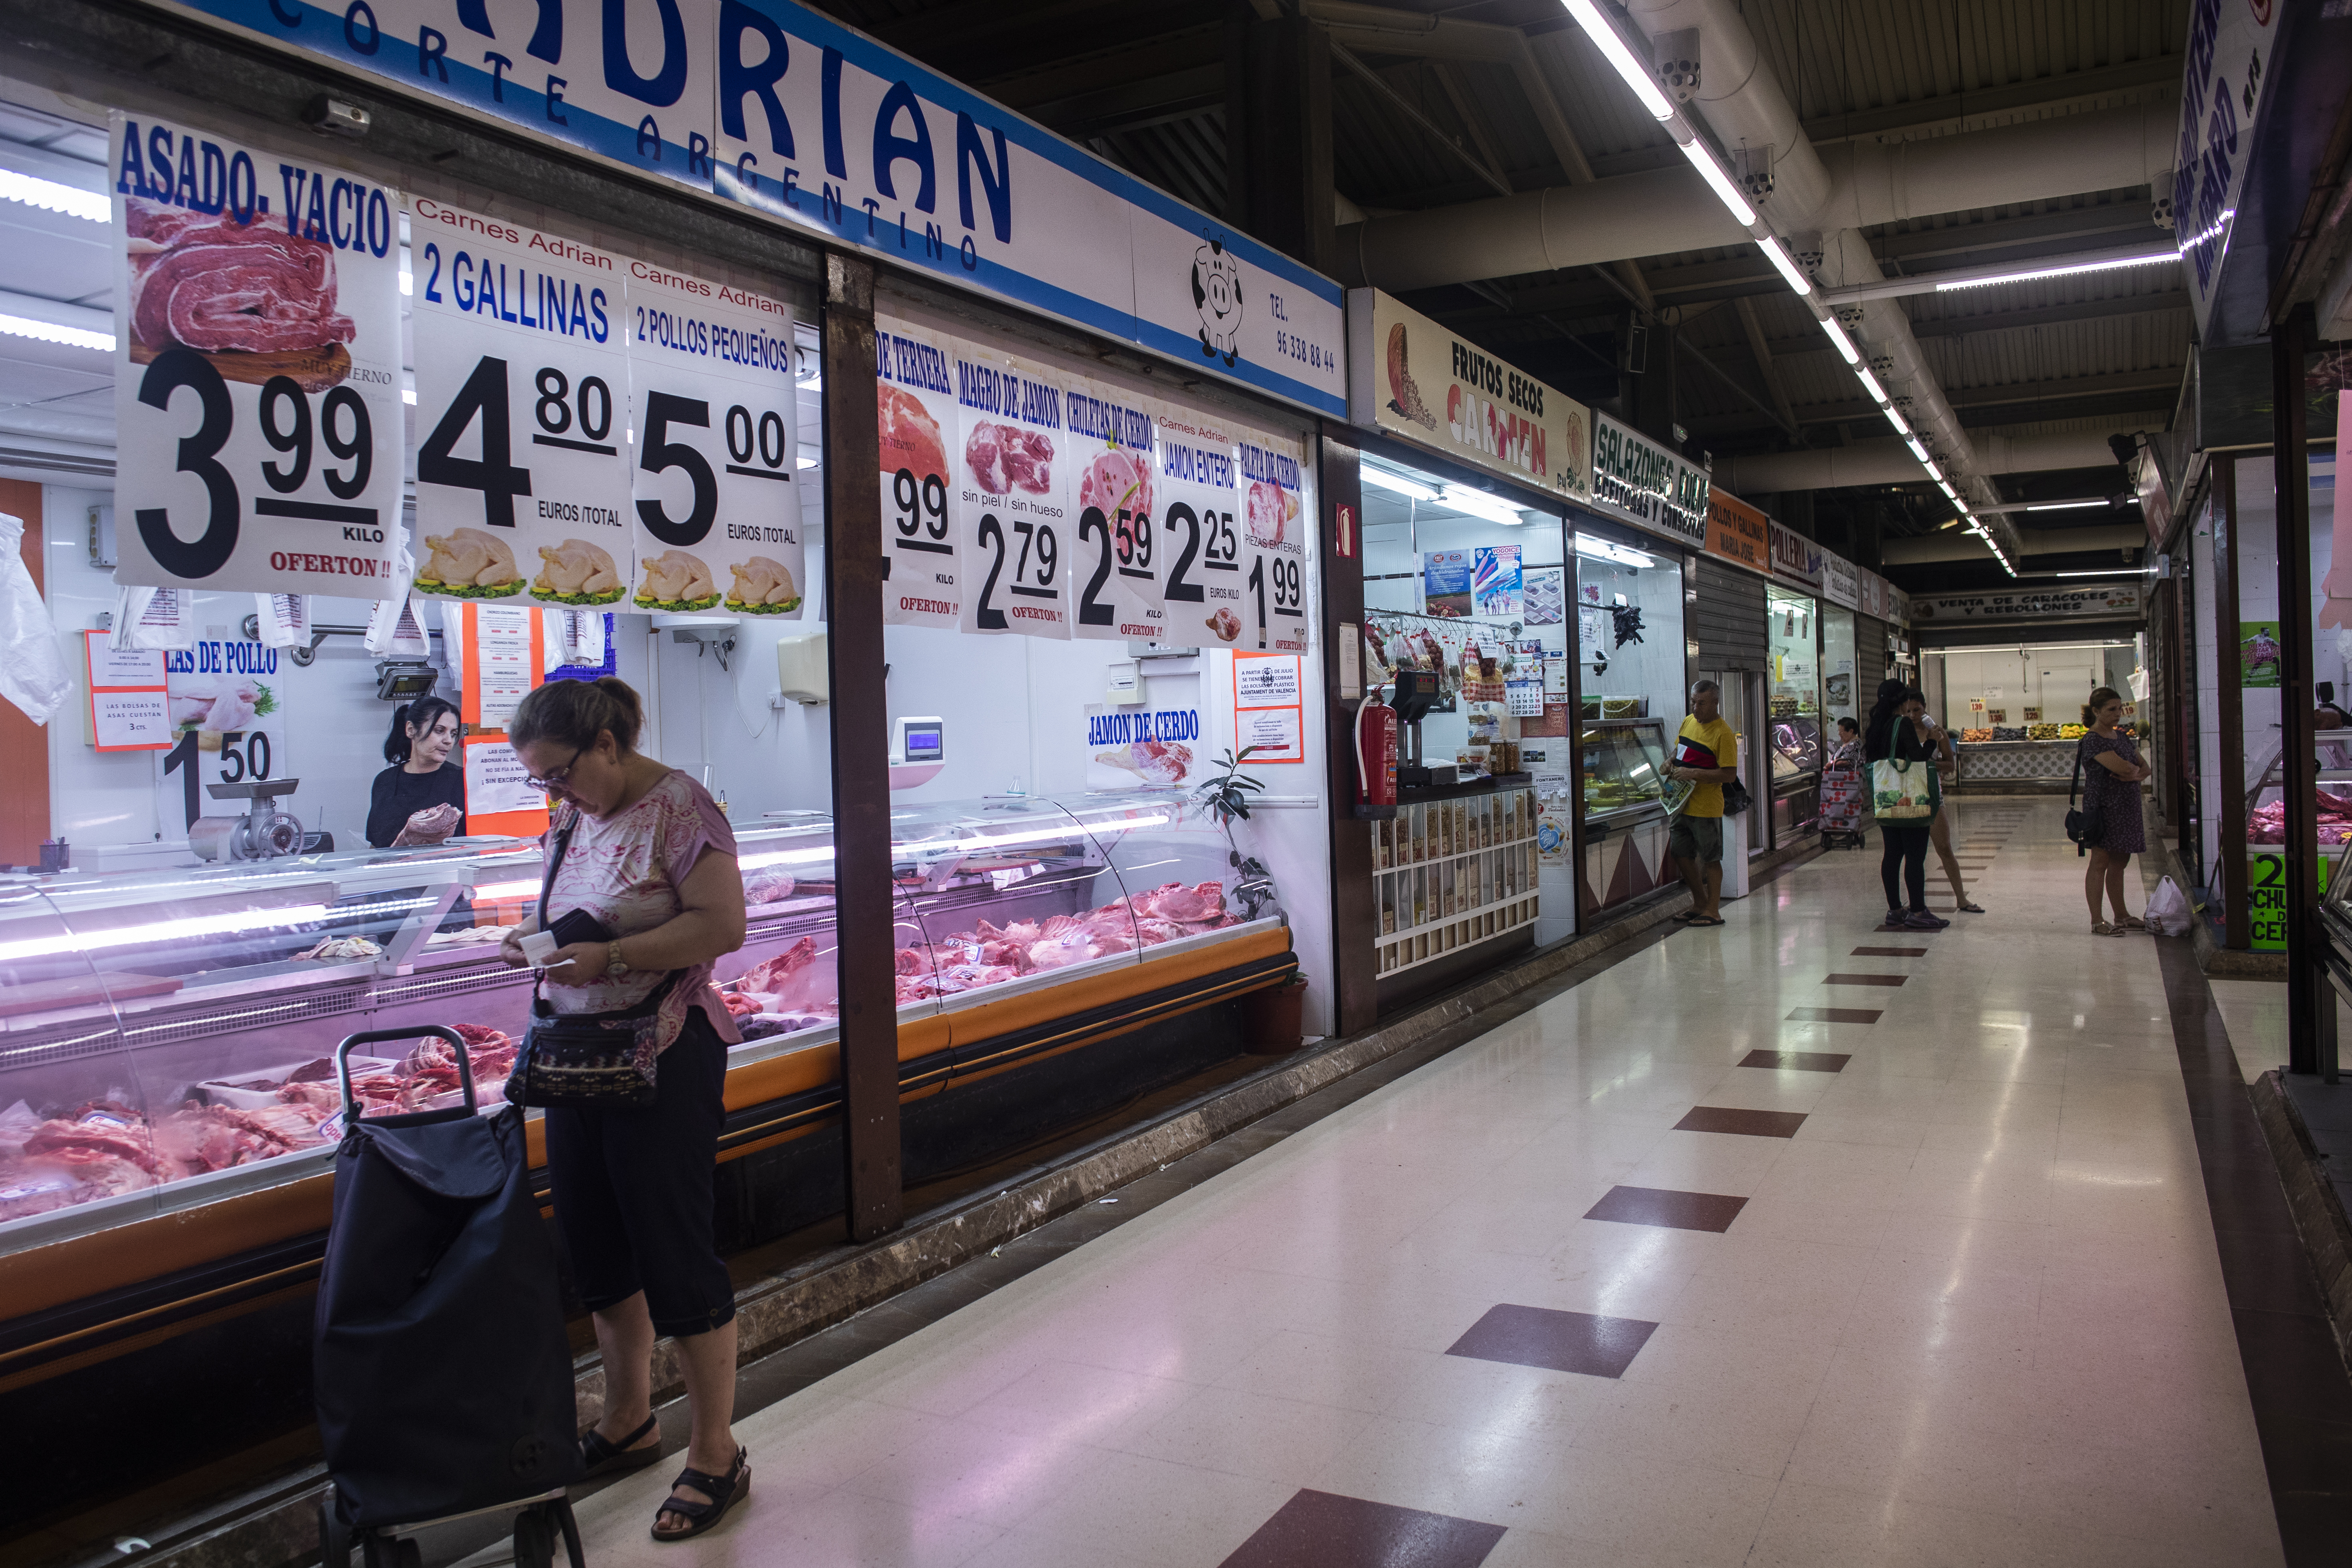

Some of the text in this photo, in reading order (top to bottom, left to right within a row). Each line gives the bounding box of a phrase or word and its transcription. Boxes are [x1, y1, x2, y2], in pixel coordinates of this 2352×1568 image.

[280, 163, 390, 258] VACIO
[637, 114, 976, 272] ARGENTINO
[415, 199, 612, 270] Carnes Adrian
[424, 243, 608, 343] 2 GALLINAS
[630, 262, 784, 316] Carnes Adrian
[1270, 294, 1288, 322] TEL.
[637, 306, 787, 372] 2 POLLOS PEQUEÑOS
[1278, 330, 1334, 374] 96 338 88 44
[893, 336, 952, 395] TERNERA
[1452, 340, 1543, 418] FRUTOS SECOS
[958, 360, 1060, 429] MAGRO DE JAMON
[418, 355, 612, 528] 4 80
[1067, 392, 1152, 453] CHULETAS DE CERDO
[1159, 416, 1228, 444] Carnes Adrian
[1447, 384, 1546, 477] CARMEN
[135, 349, 372, 578] 3 99
[889, 438, 915, 452] TIERNO
[1165, 441, 1233, 489] JAMON ENTERO
[1597, 423, 1673, 499] SALAZONES
[635, 390, 785, 547] 5 00
[1239, 442, 1300, 492] PALETA DE CERDO
[539, 501, 579, 522] EUROS
[893, 468, 948, 540] 99
[962, 489, 1063, 518] sin piel sin hueso
[1708, 501, 1763, 543] POLLOS Y GALLINAS
[343, 527, 384, 543] KILO
[728, 524, 760, 541] EUROS
[1164, 502, 1236, 602] 2 25
[1245, 534, 1301, 554] PIEZAS ENTERAS
[1720, 532, 1739, 557] MARIA
[1771, 525, 1806, 573] POLLERIA
[270, 552, 377, 577] OFERTON
[936, 573, 954, 585] KILO
[977, 514, 1057, 629] 2 79
[1079, 506, 1152, 626] 2 59
[900, 597, 950, 614] OFERTON
[1012, 607, 1056, 622] OFERTON
[1146, 610, 1162, 618] KILO
[1210, 588, 1227, 599] EUROS
[1249, 555, 1300, 648] 1 99
[1939, 599, 1984, 607] VENTA
[2022, 592, 2108, 603] CARACOLES
[1984, 602, 2082, 614] REBOLLONES
[1121, 624, 1155, 636] OFERTON
[1276, 640, 1302, 651] OFERTON
[200, 642, 277, 674] DE POLLO
[1089, 709, 1199, 746] JAMON DE CERDO
[164, 731, 270, 834] 1 50
[1541, 830, 1552, 838] Sin
[1543, 837, 1555, 848] Sal
[2256, 854, 2285, 888] 2
